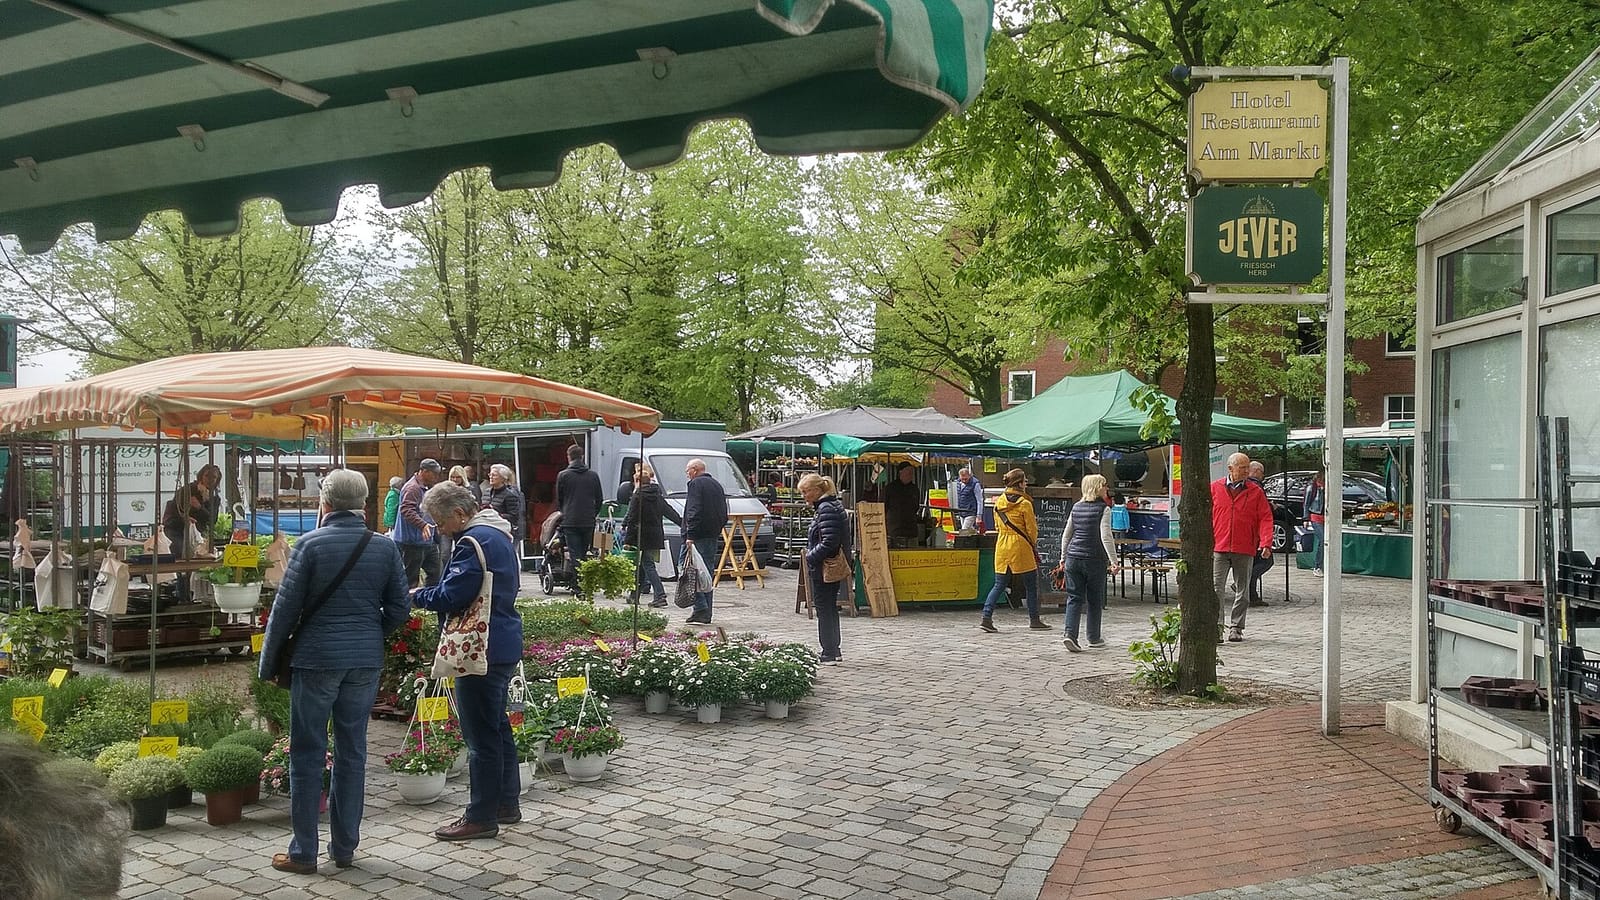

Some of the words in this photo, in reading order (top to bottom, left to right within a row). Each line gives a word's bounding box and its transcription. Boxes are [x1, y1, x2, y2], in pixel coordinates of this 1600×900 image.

[1231, 90, 1291, 109] Hotel
[1201, 113, 1320, 130] Restaurant
[1199, 142, 1240, 161] Am
[1248, 141, 1320, 160] Markt
[1218, 216, 1297, 259] JEVER
